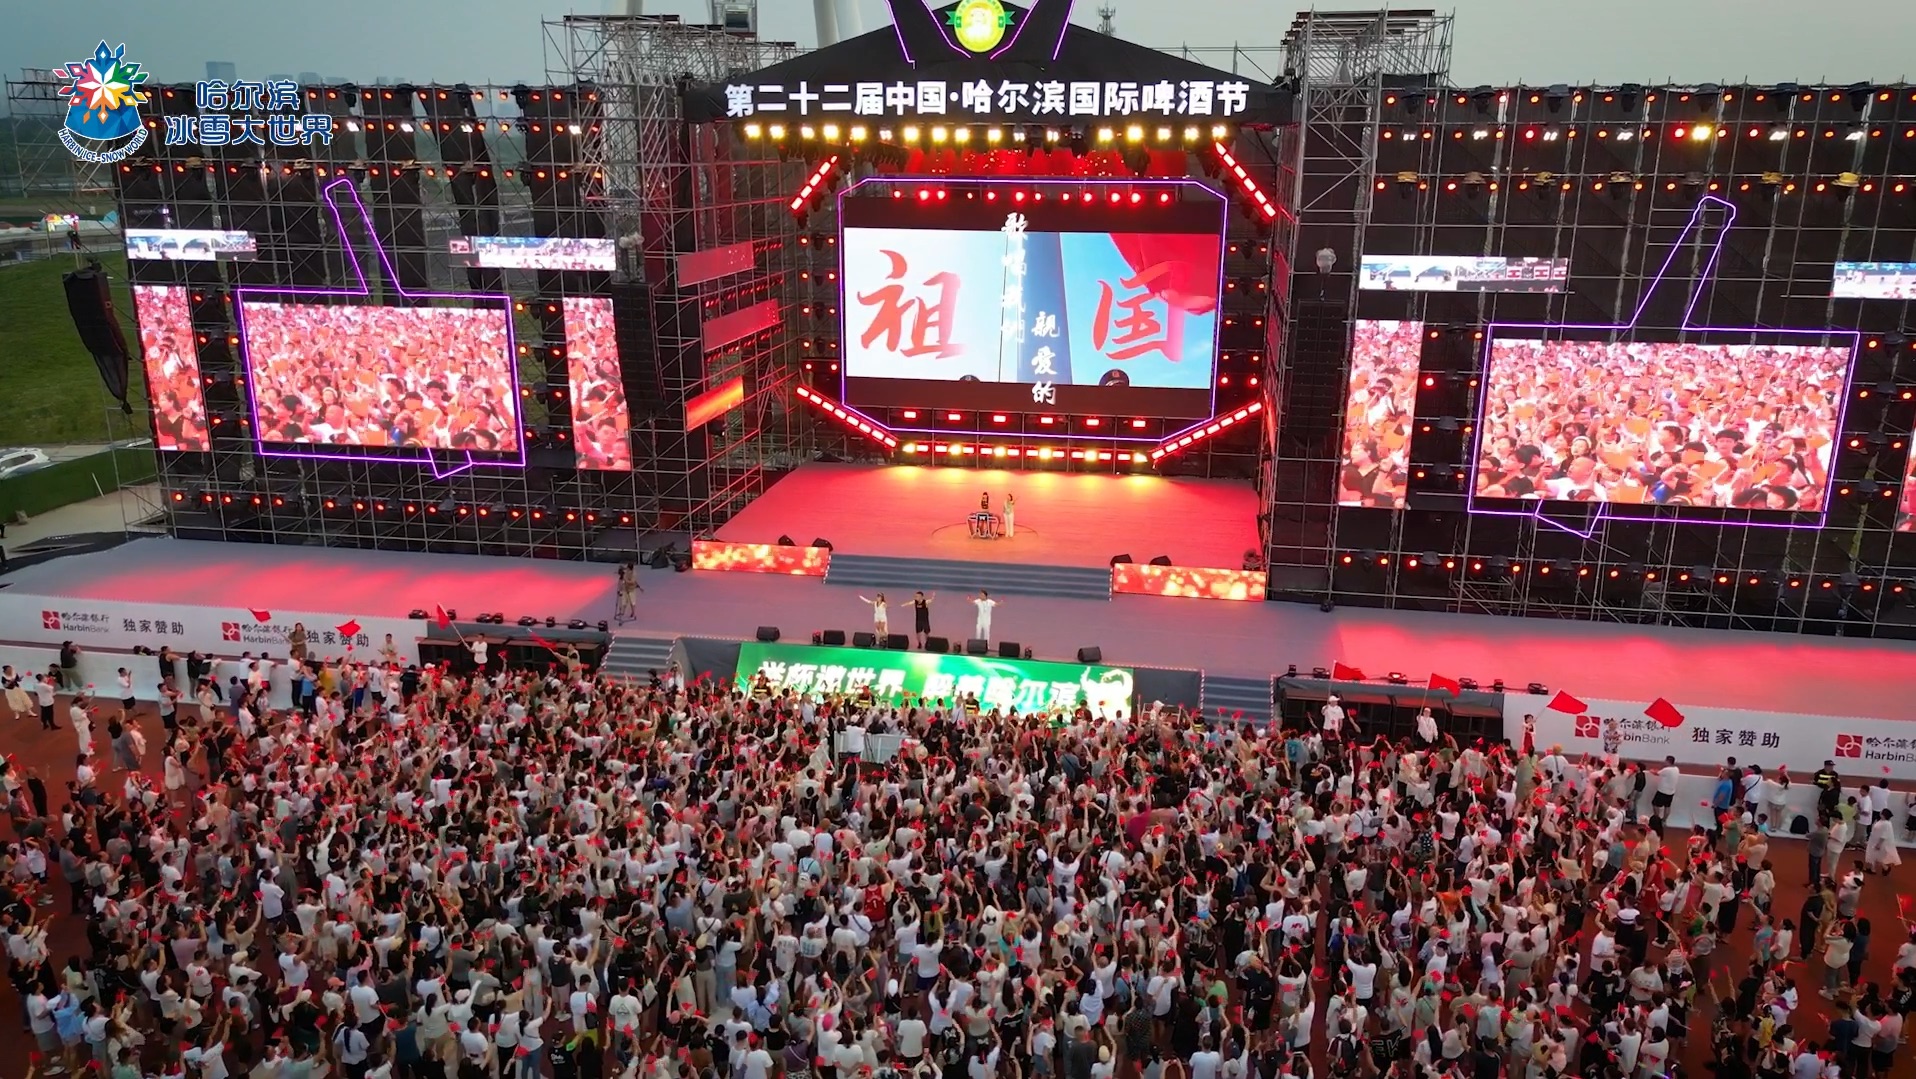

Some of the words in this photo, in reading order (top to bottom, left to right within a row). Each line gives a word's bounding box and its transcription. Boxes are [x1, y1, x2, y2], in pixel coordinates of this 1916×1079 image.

[725, 80, 1249, 117] 第二十二届中国·哈尔滨国际啤酒节
[123, 618, 184, 635] 独家赞助
[1692, 727, 1780, 748] 独家赞助
